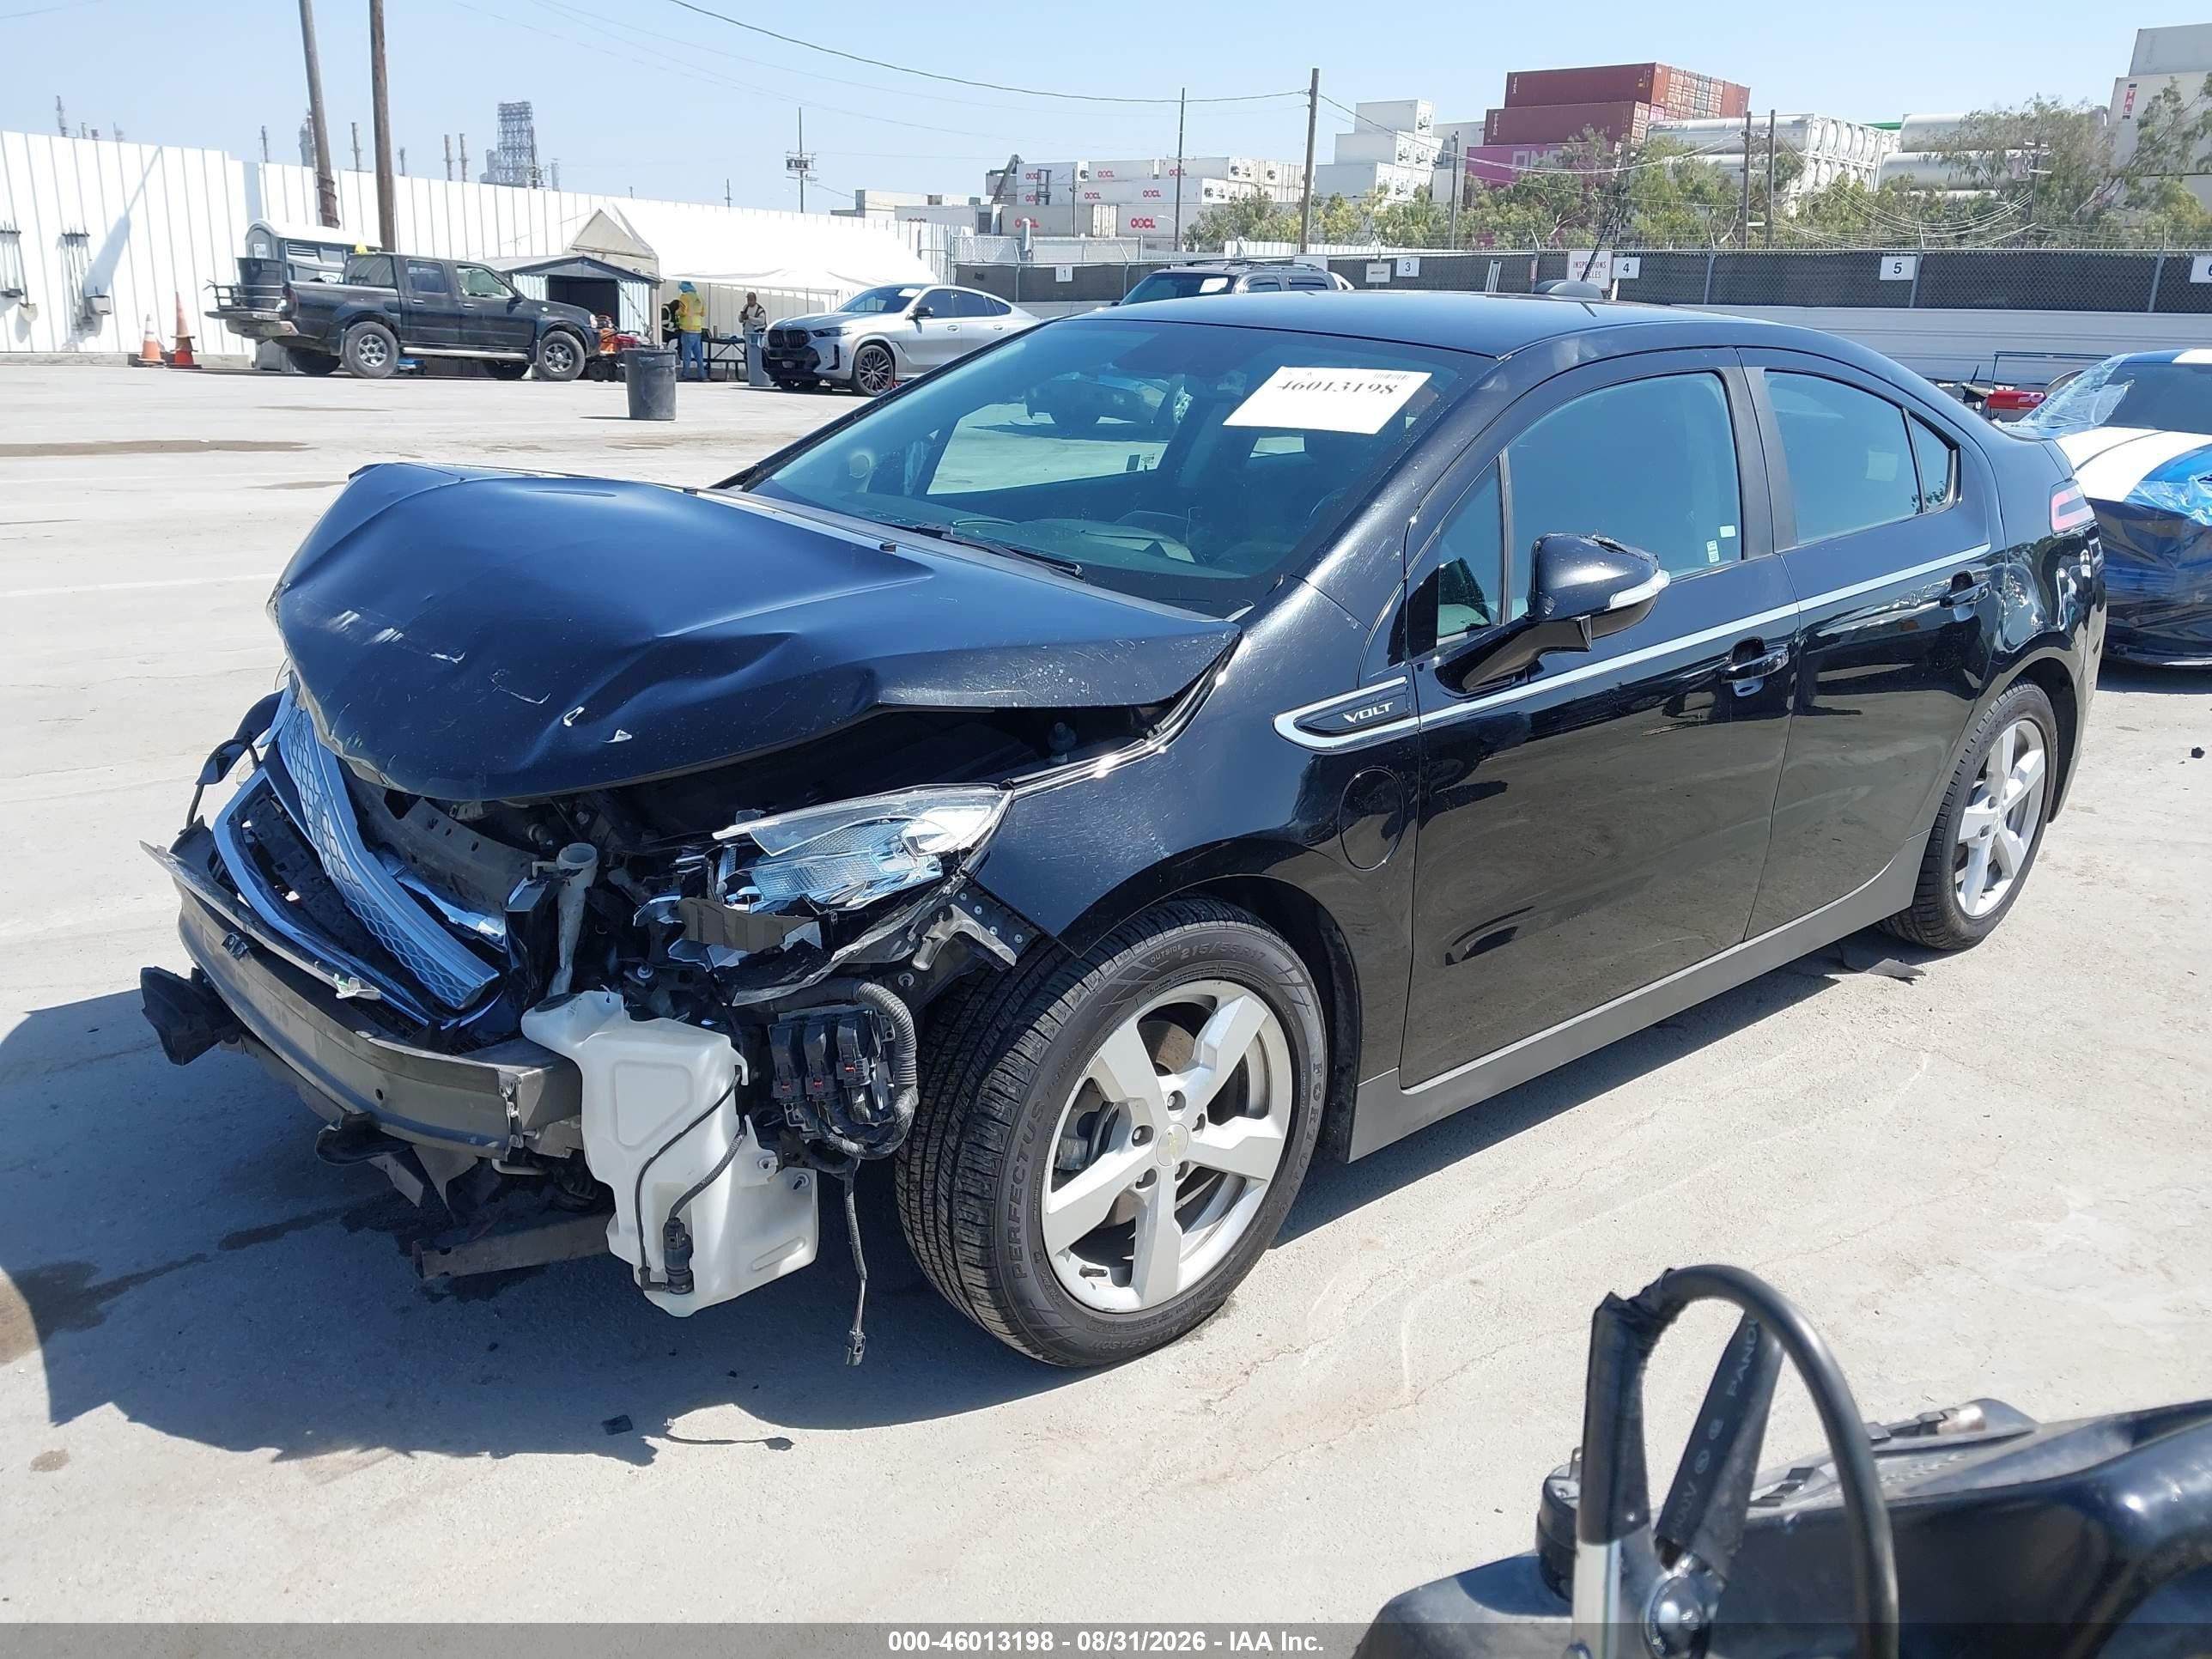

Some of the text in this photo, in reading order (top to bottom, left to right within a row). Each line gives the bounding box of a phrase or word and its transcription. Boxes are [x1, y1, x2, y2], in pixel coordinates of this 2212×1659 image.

[1169, 168, 1187, 177] OOL
[1143, 189, 1161, 198] OOCL
[1015, 218, 1039, 228] OCL
[1130, 217, 1156, 228] OOCL
[1405, 261, 1411, 272] 3
[1573, 260, 1607, 269] INSPEIONS
[1623, 263, 1630, 273] 4
[1893, 262, 1903, 274] 5
[1277, 380, 1400, 395] 46013198
[1342, 702, 1394, 724] VOLT
[1008, 1098, 1046, 1279] PERFECTUS
